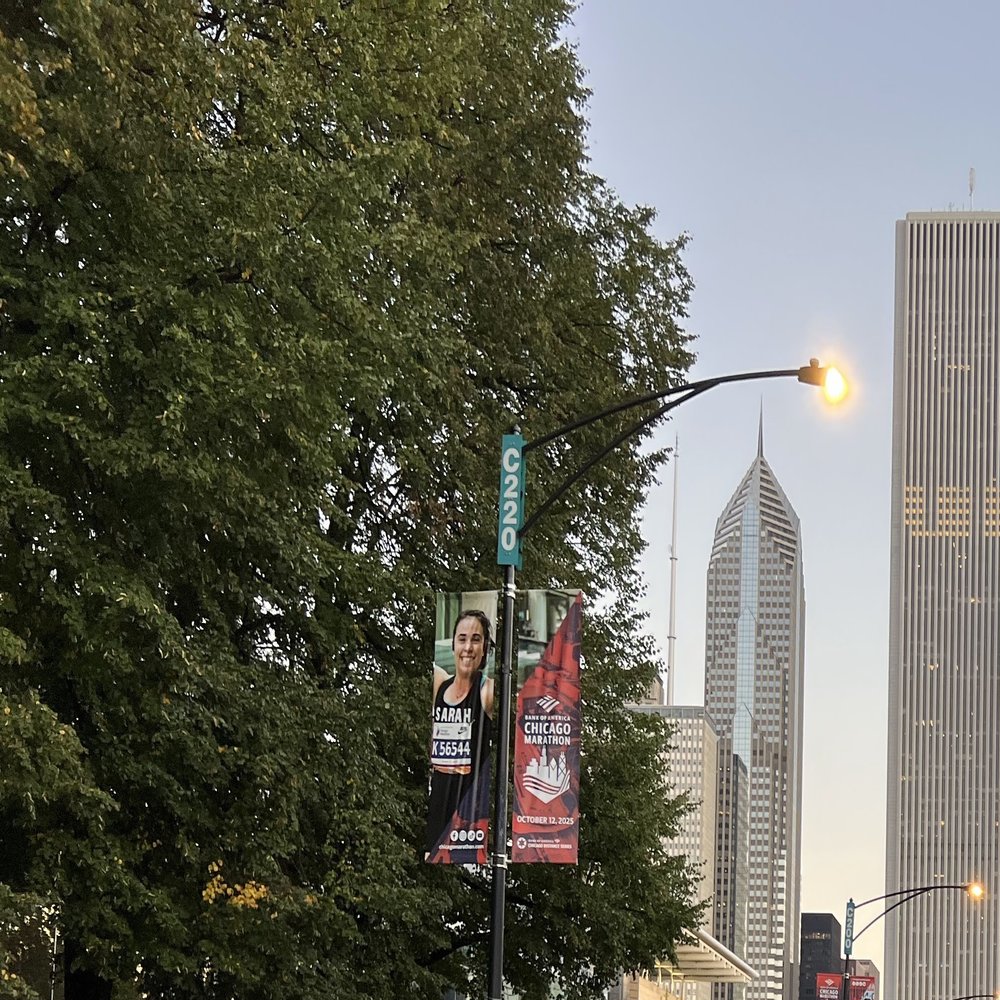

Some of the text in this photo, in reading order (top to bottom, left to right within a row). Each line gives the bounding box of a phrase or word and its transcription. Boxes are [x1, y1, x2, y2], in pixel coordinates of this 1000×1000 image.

[501, 447, 520, 551] C220
[435, 706, 471, 723] SARAH
[524, 722, 571, 735] CHICAGO
[524, 735, 571, 745] MARATHON
[517, 815, 547, 824] OCTOBER
[558, 817, 574, 825] 2025
[845, 907, 854, 949] C200
